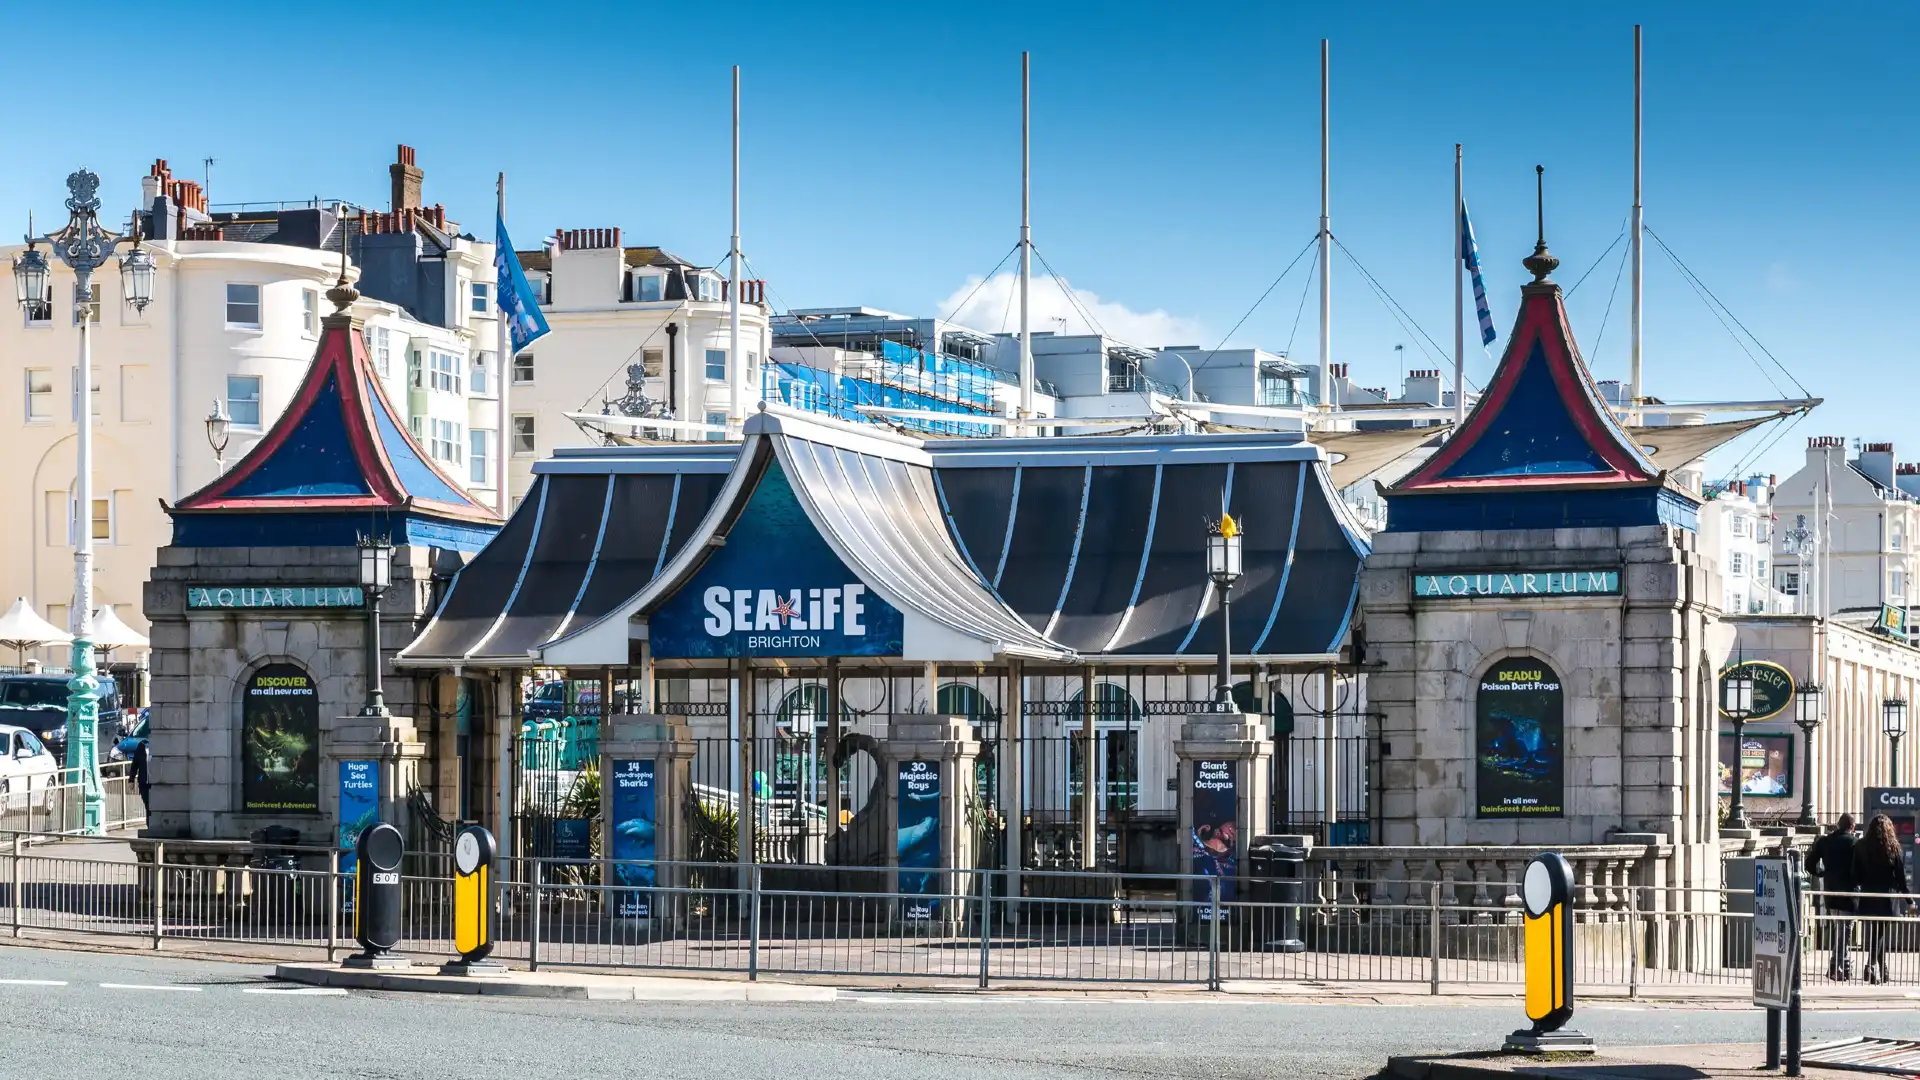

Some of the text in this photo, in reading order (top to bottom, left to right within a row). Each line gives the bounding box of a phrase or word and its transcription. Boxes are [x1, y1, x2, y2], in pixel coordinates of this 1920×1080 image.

[1426, 572, 1608, 595] AQUARIUM
[198, 588, 355, 607] AQUARIUM
[703, 585, 781, 637] SEA
[749, 636, 820, 648] BRIGHTON
[1499, 670, 1542, 681] DEADLY
[256, 677, 307, 687] DISCOVER
[1481, 681, 1559, 691] Poison Dart Frogs
[263, 687, 274, 695] all
[348, 763, 369, 772] Huge
[628, 762, 640, 772] 14
[911, 762, 927, 772] 30
[1201, 761, 1228, 770] Giant
[351, 772, 366, 780] Sea
[615, 771, 653, 780] Jaw-dropping
[900, 771, 938, 782] Majestic
[1199, 770, 1230, 780] Pacific
[344, 781, 373, 789] Turtles
[619, 779, 648, 788] Sharks
[907, 781, 930, 791] Rays
[1195, 780, 1234, 792] Octopus
[1512, 797, 1522, 805] all
[1880, 792, 1915, 805] Cash
[246, 801, 281, 809] Rainforest
[1480, 805, 1561, 813] Rainforest Adventure
